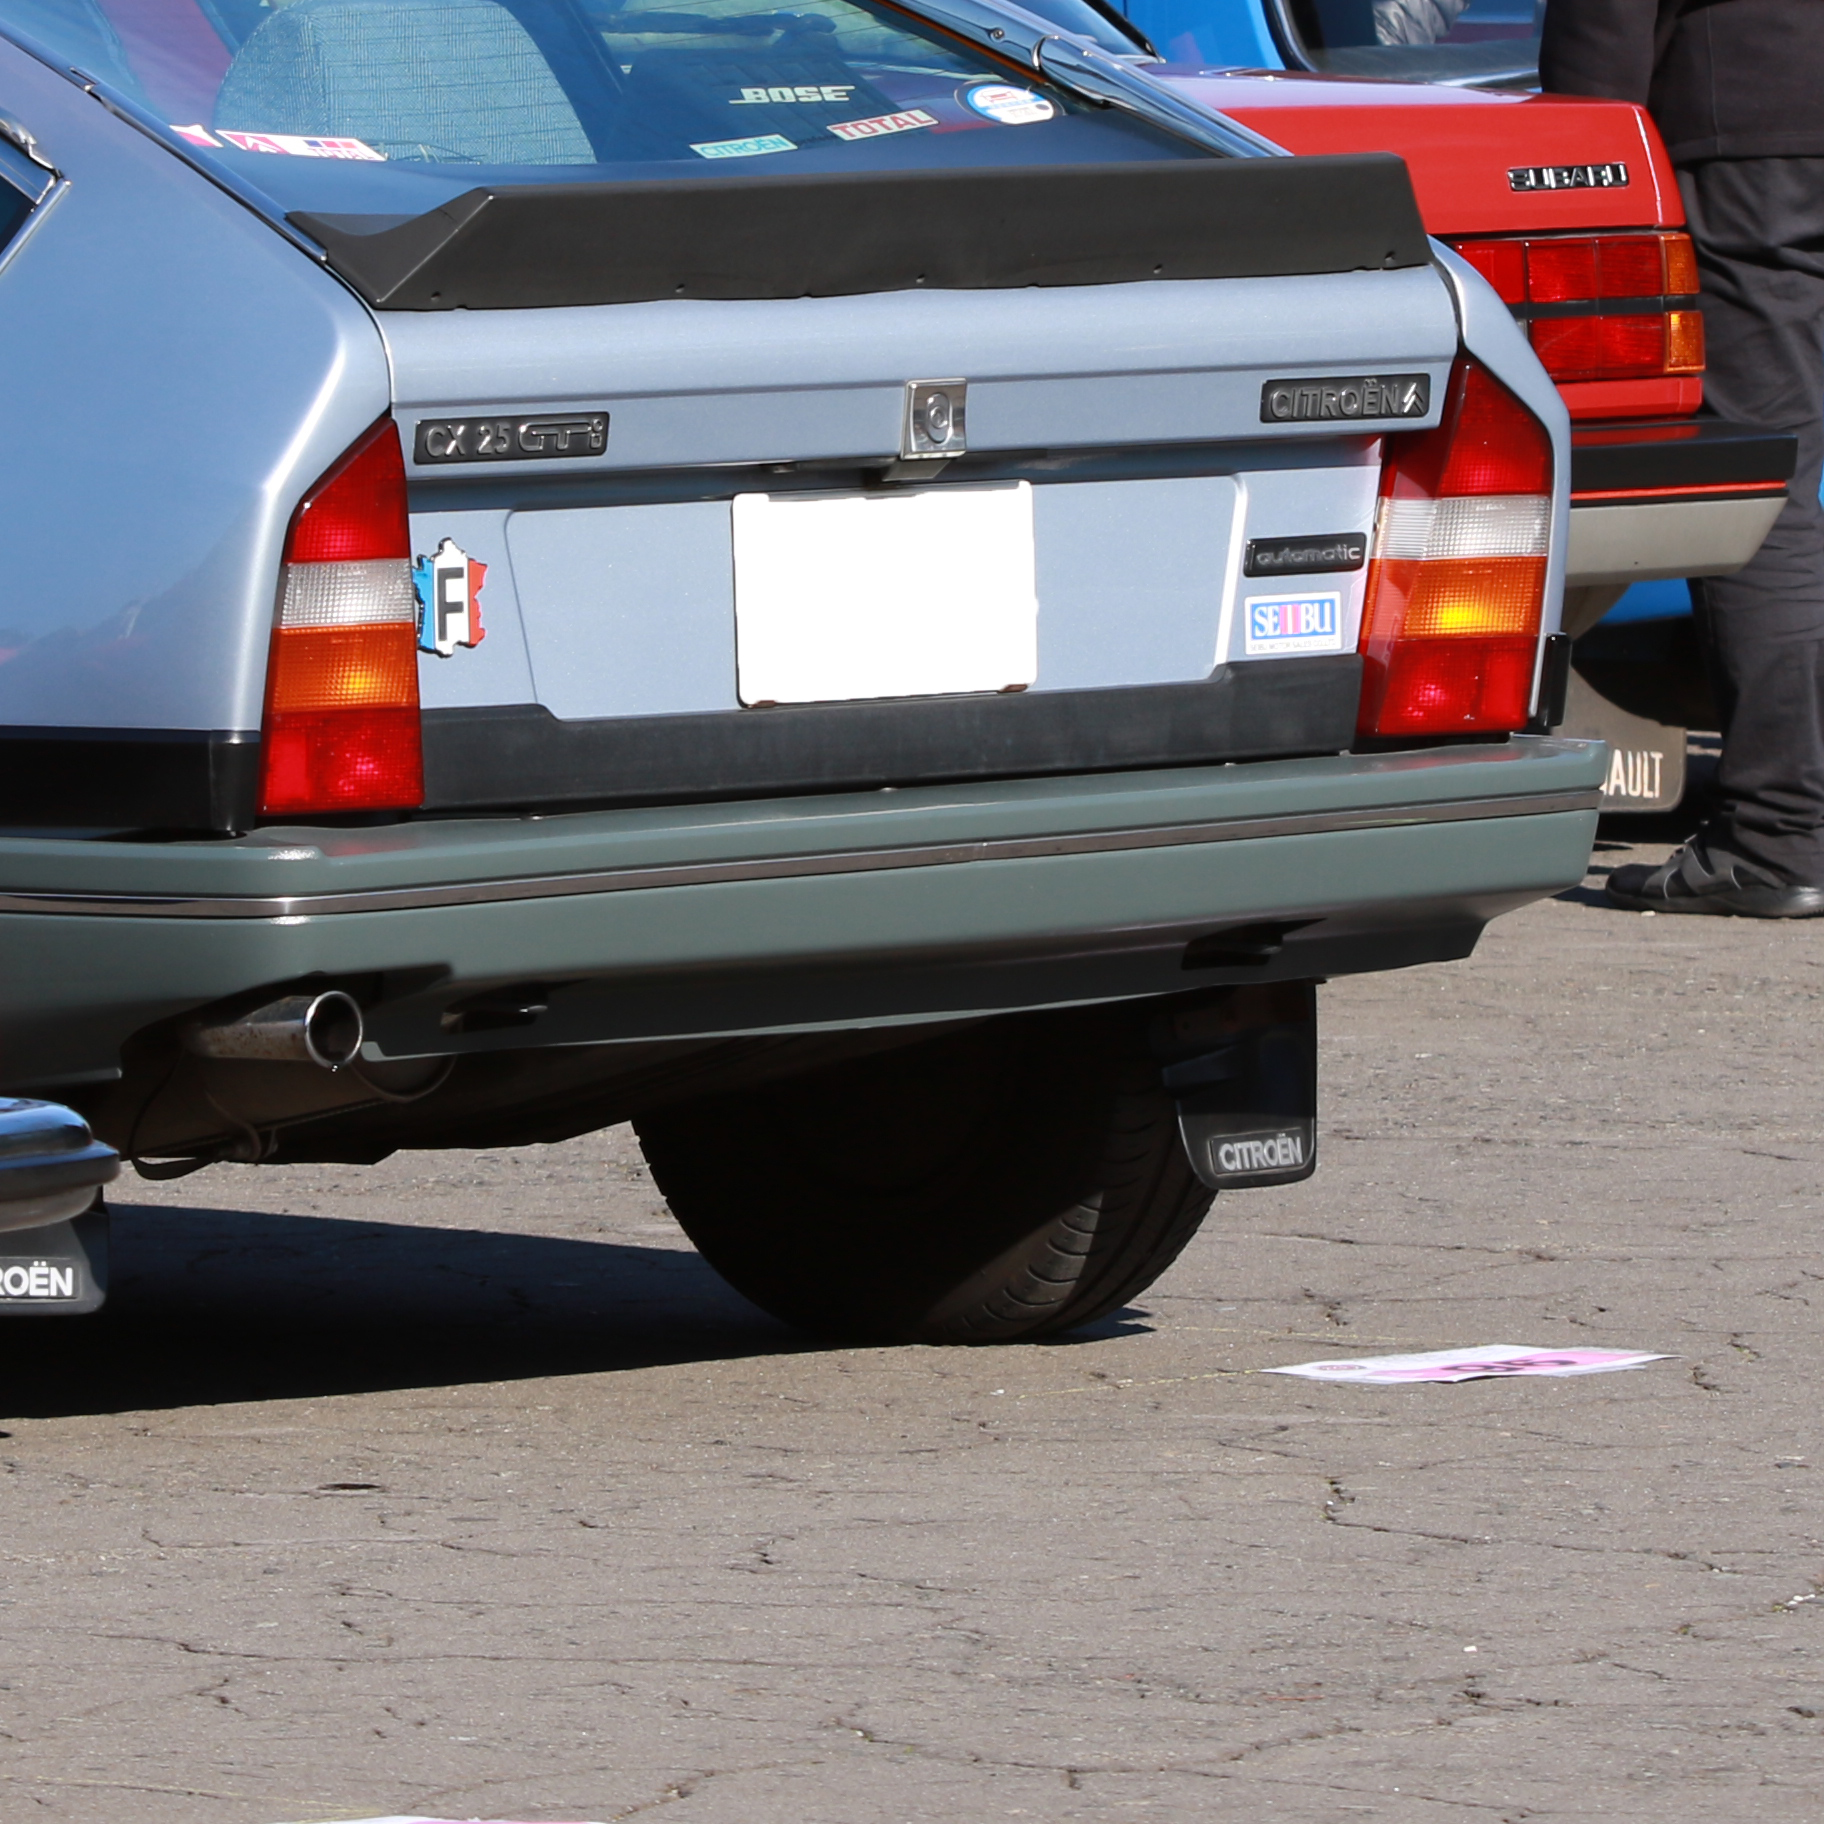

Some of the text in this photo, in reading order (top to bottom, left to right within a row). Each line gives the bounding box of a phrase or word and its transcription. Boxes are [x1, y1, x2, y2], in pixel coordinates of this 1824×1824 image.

[729, 85, 855, 104] BOSE
[831, 111, 934, 138] TOTAL
[698, 136, 788, 158] CITROËN
[1508, 163, 1629, 191] SUBARU
[1271, 378, 1399, 419] CITROËN
[425, 425, 465, 457] CX
[477, 424, 511, 455] 25
[1256, 544, 1361, 567] automatic
[437, 567, 465, 642] F
[1599, 749, 1663, 798] AULT
[1218, 1133, 1303, 1171] CITROËN
